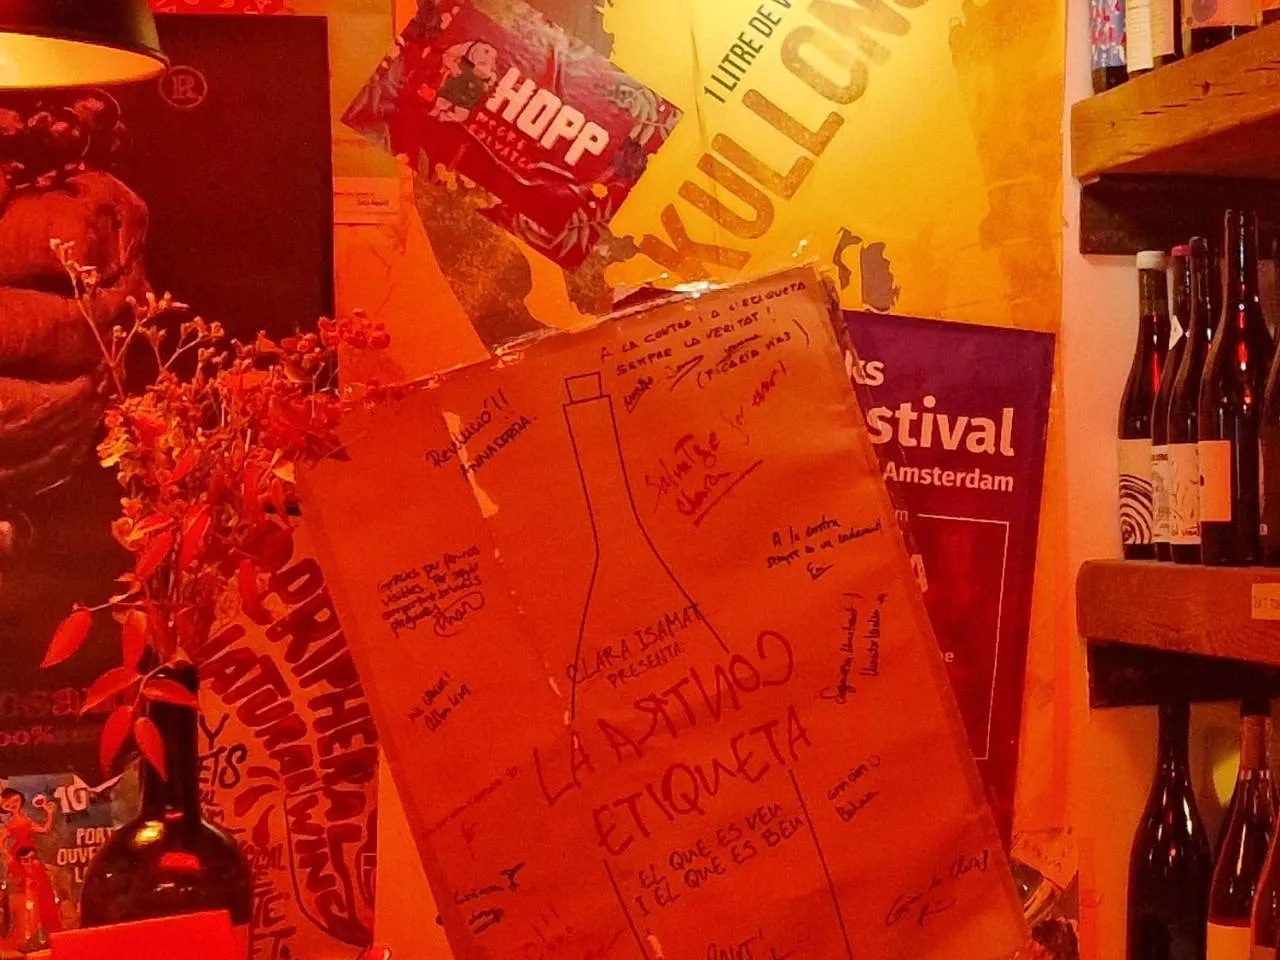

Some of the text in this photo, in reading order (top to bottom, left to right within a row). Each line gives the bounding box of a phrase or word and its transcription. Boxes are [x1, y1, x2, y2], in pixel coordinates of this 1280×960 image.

[710, 30, 764, 95] LITRE
[747, 3, 783, 40] DE
[485, 66, 610, 167] HOPP
[616, 347, 673, 377] SEMPRE
[866, 395, 1016, 458] stival
[883, 460, 1015, 493] Amsterdam
[566, 602, 703, 684] CLARA ISAMAT
[592, 703, 813, 857] ETIQUETA
[637, 862, 667, 891] EL
[668, 838, 714, 872] QUE
[715, 822, 743, 848] ES
[653, 880, 682, 909] EL
[684, 855, 728, 890] QUE
[730, 838, 759, 868] ES
